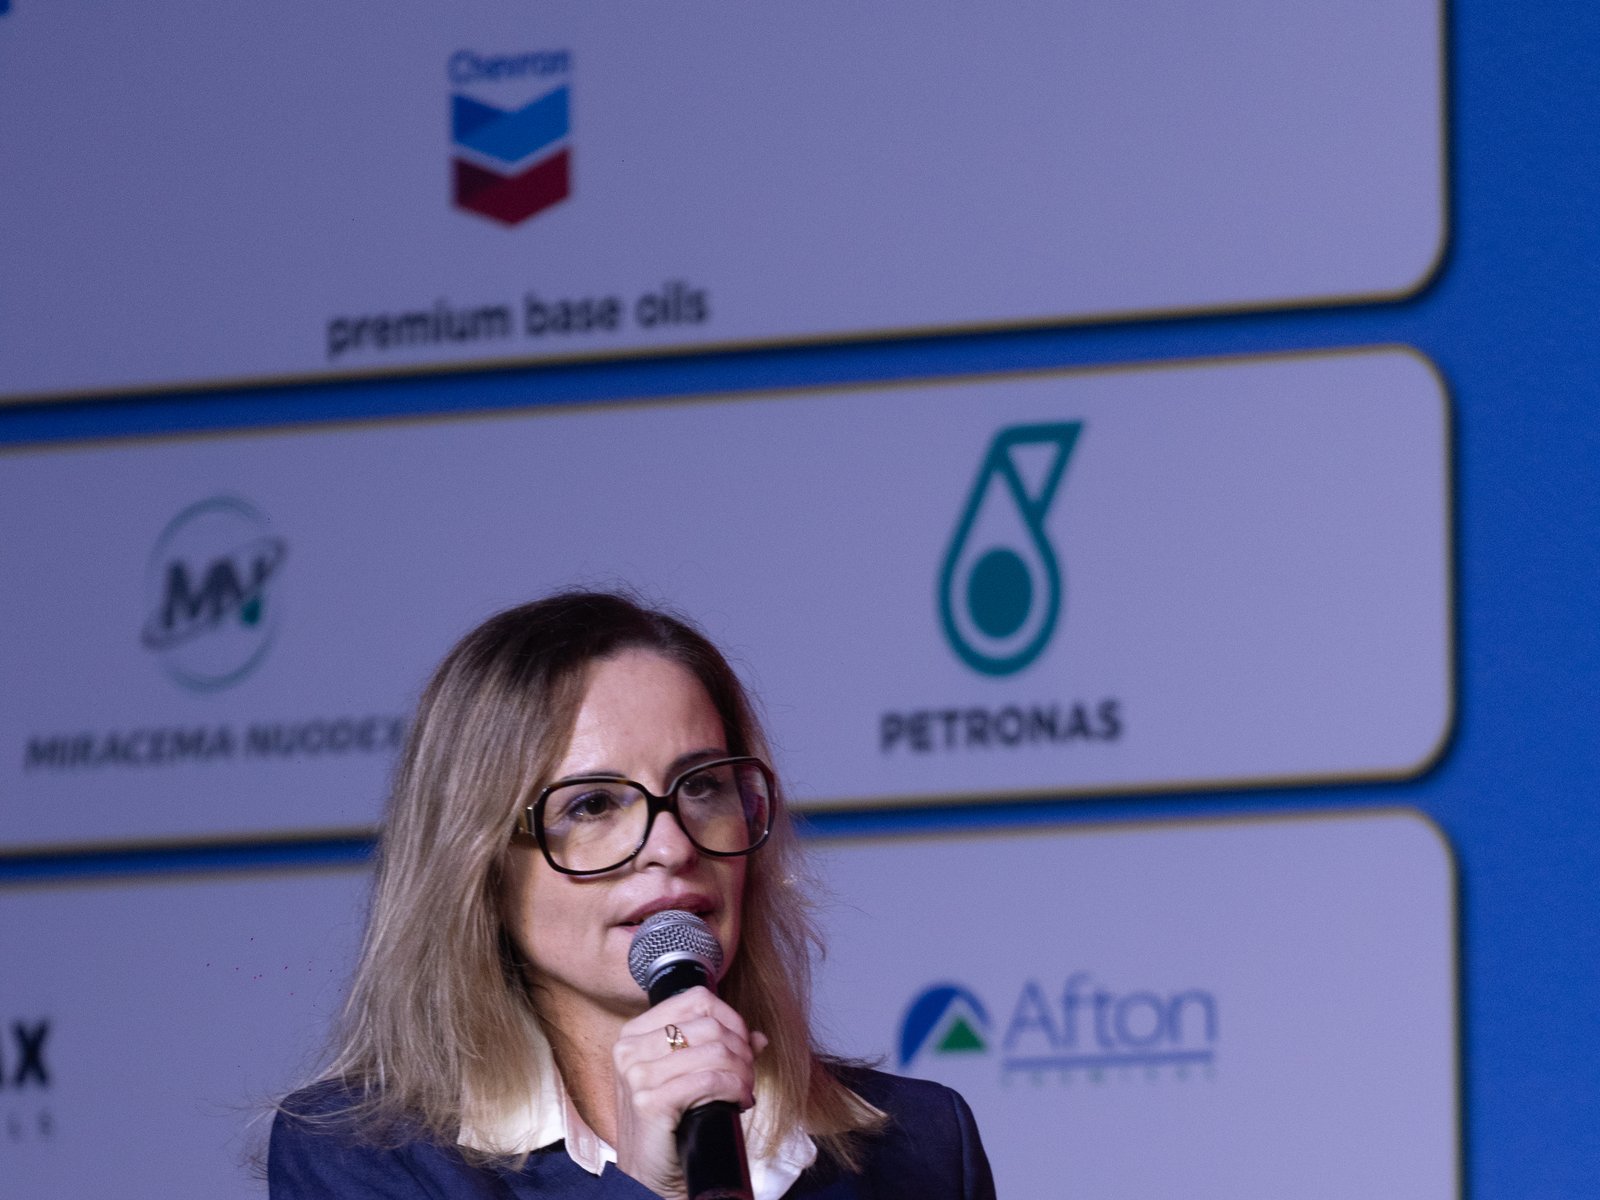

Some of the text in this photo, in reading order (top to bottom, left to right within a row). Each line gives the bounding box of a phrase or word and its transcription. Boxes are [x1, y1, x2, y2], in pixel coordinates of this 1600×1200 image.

[447, 49, 571, 83] Chevron
[327, 280, 709, 357] premium base oils
[880, 699, 1122, 752] PETRONAS
[1001, 970, 1218, 1050] Afton
